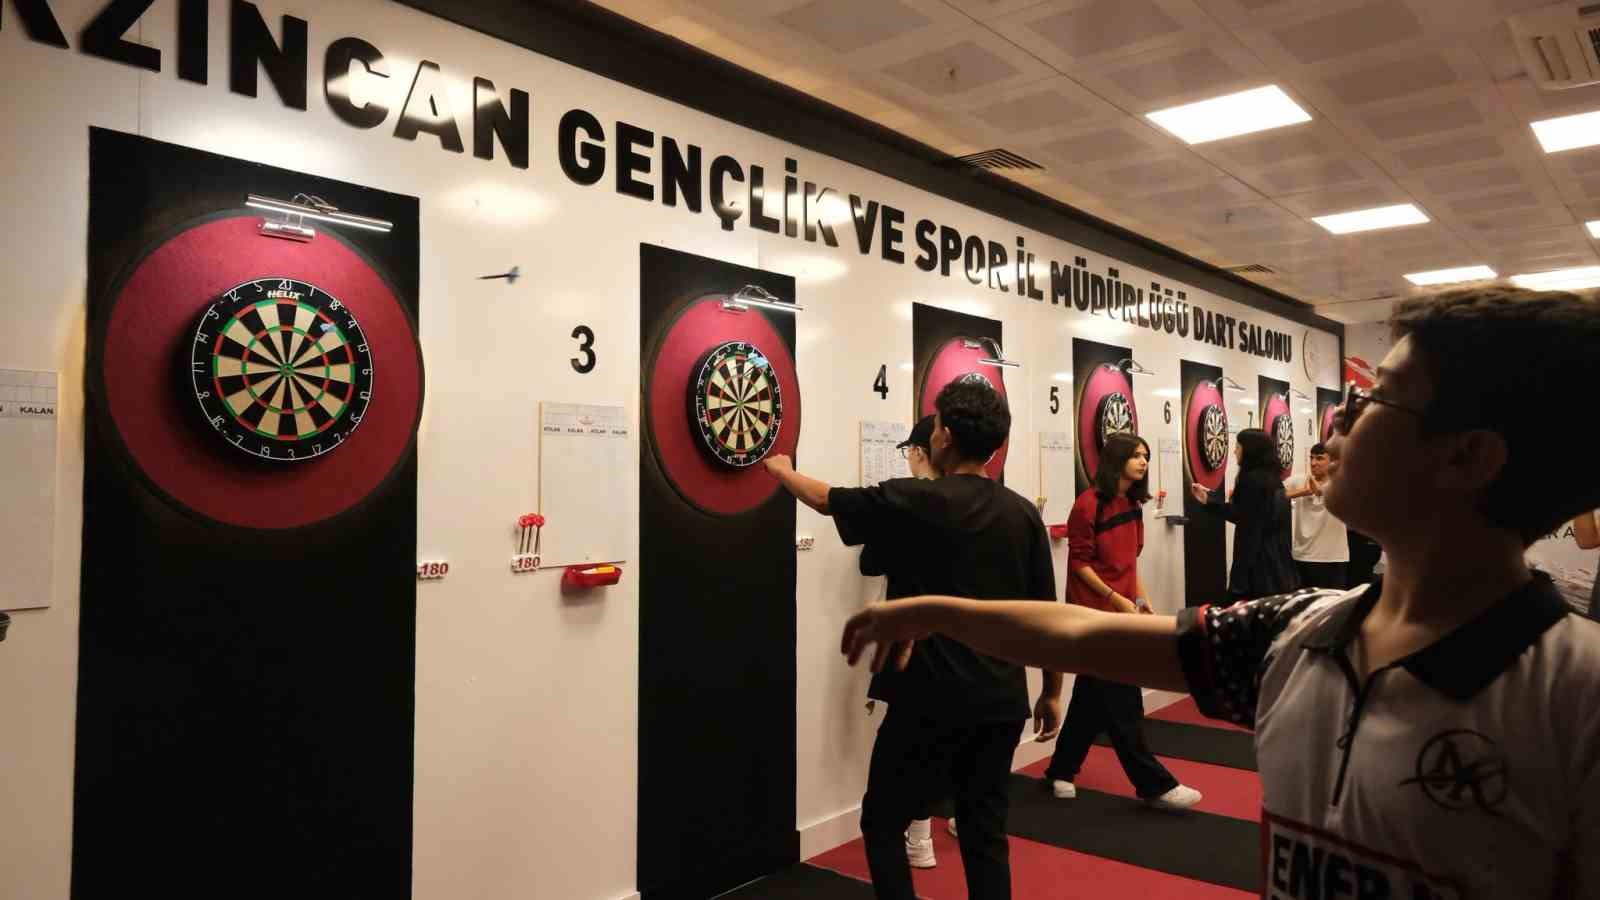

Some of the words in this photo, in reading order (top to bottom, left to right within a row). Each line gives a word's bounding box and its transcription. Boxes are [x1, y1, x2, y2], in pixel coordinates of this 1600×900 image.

[0, 0, 530, 169] ZINCAN
[558, 108, 839, 249] GENÇLİK
[849, 194, 906, 264] VE
[915, 218, 1009, 295] SPOR
[1015, 236, 1044, 303] İL
[1049, 256, 1190, 338] MÜDÜRLÜĞÜ
[1193, 306, 1236, 350] DART
[1238, 320, 1293, 364] SALONU
[267, 290, 299, 300] HELIX
[570, 325, 596, 374] 3
[873, 364, 889, 400] 4
[1049, 386, 1060, 414] 5
[20, 407, 54, 415] KALAN
[1163, 401, 1171, 424] 6
[1248, 411, 1253, 429] 7
[420, 562, 449, 576] 180
[514, 556, 541, 570] 180
